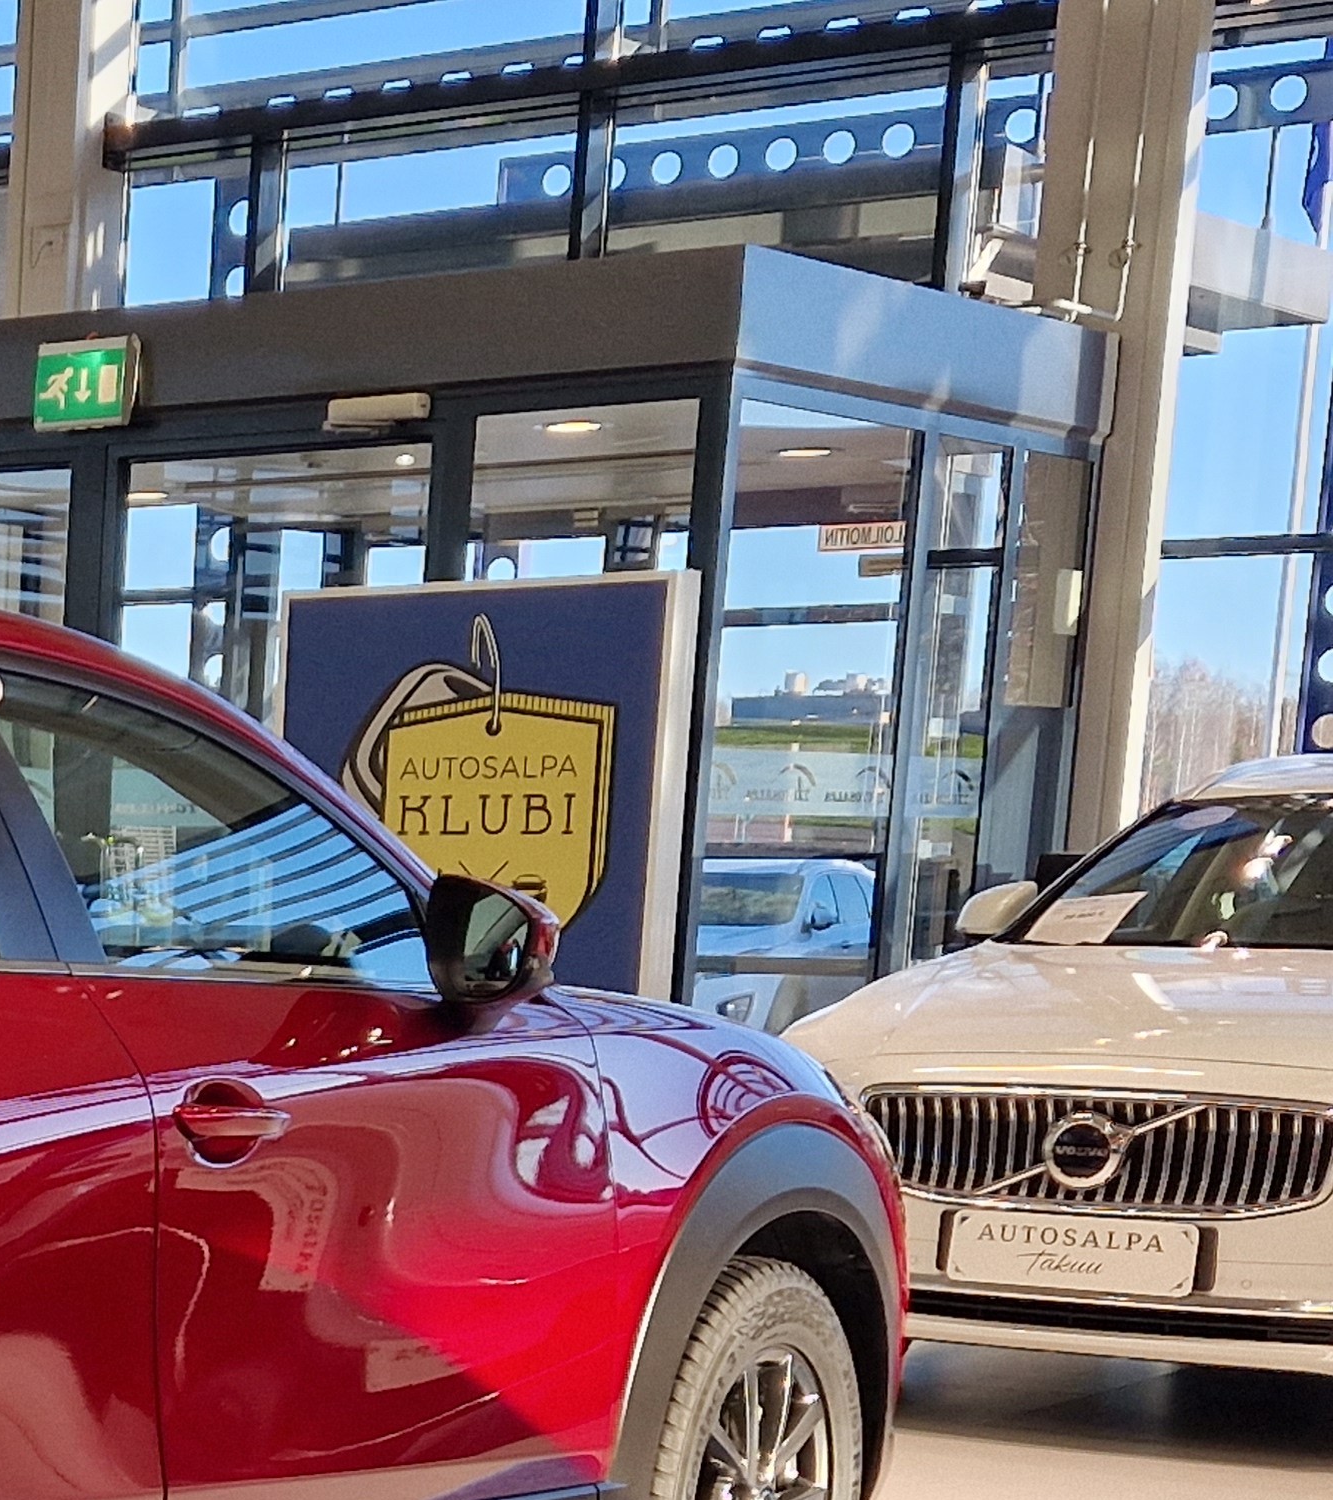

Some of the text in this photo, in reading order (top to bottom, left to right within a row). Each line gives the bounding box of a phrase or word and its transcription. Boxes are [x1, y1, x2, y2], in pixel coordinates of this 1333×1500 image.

[400, 754, 577, 780] AUTOSALPA
[397, 793, 576, 836] KLUBI
[977, 1222, 1165, 1253] AUTOSALPA
[1017, 1250, 1104, 1276] Takuu
